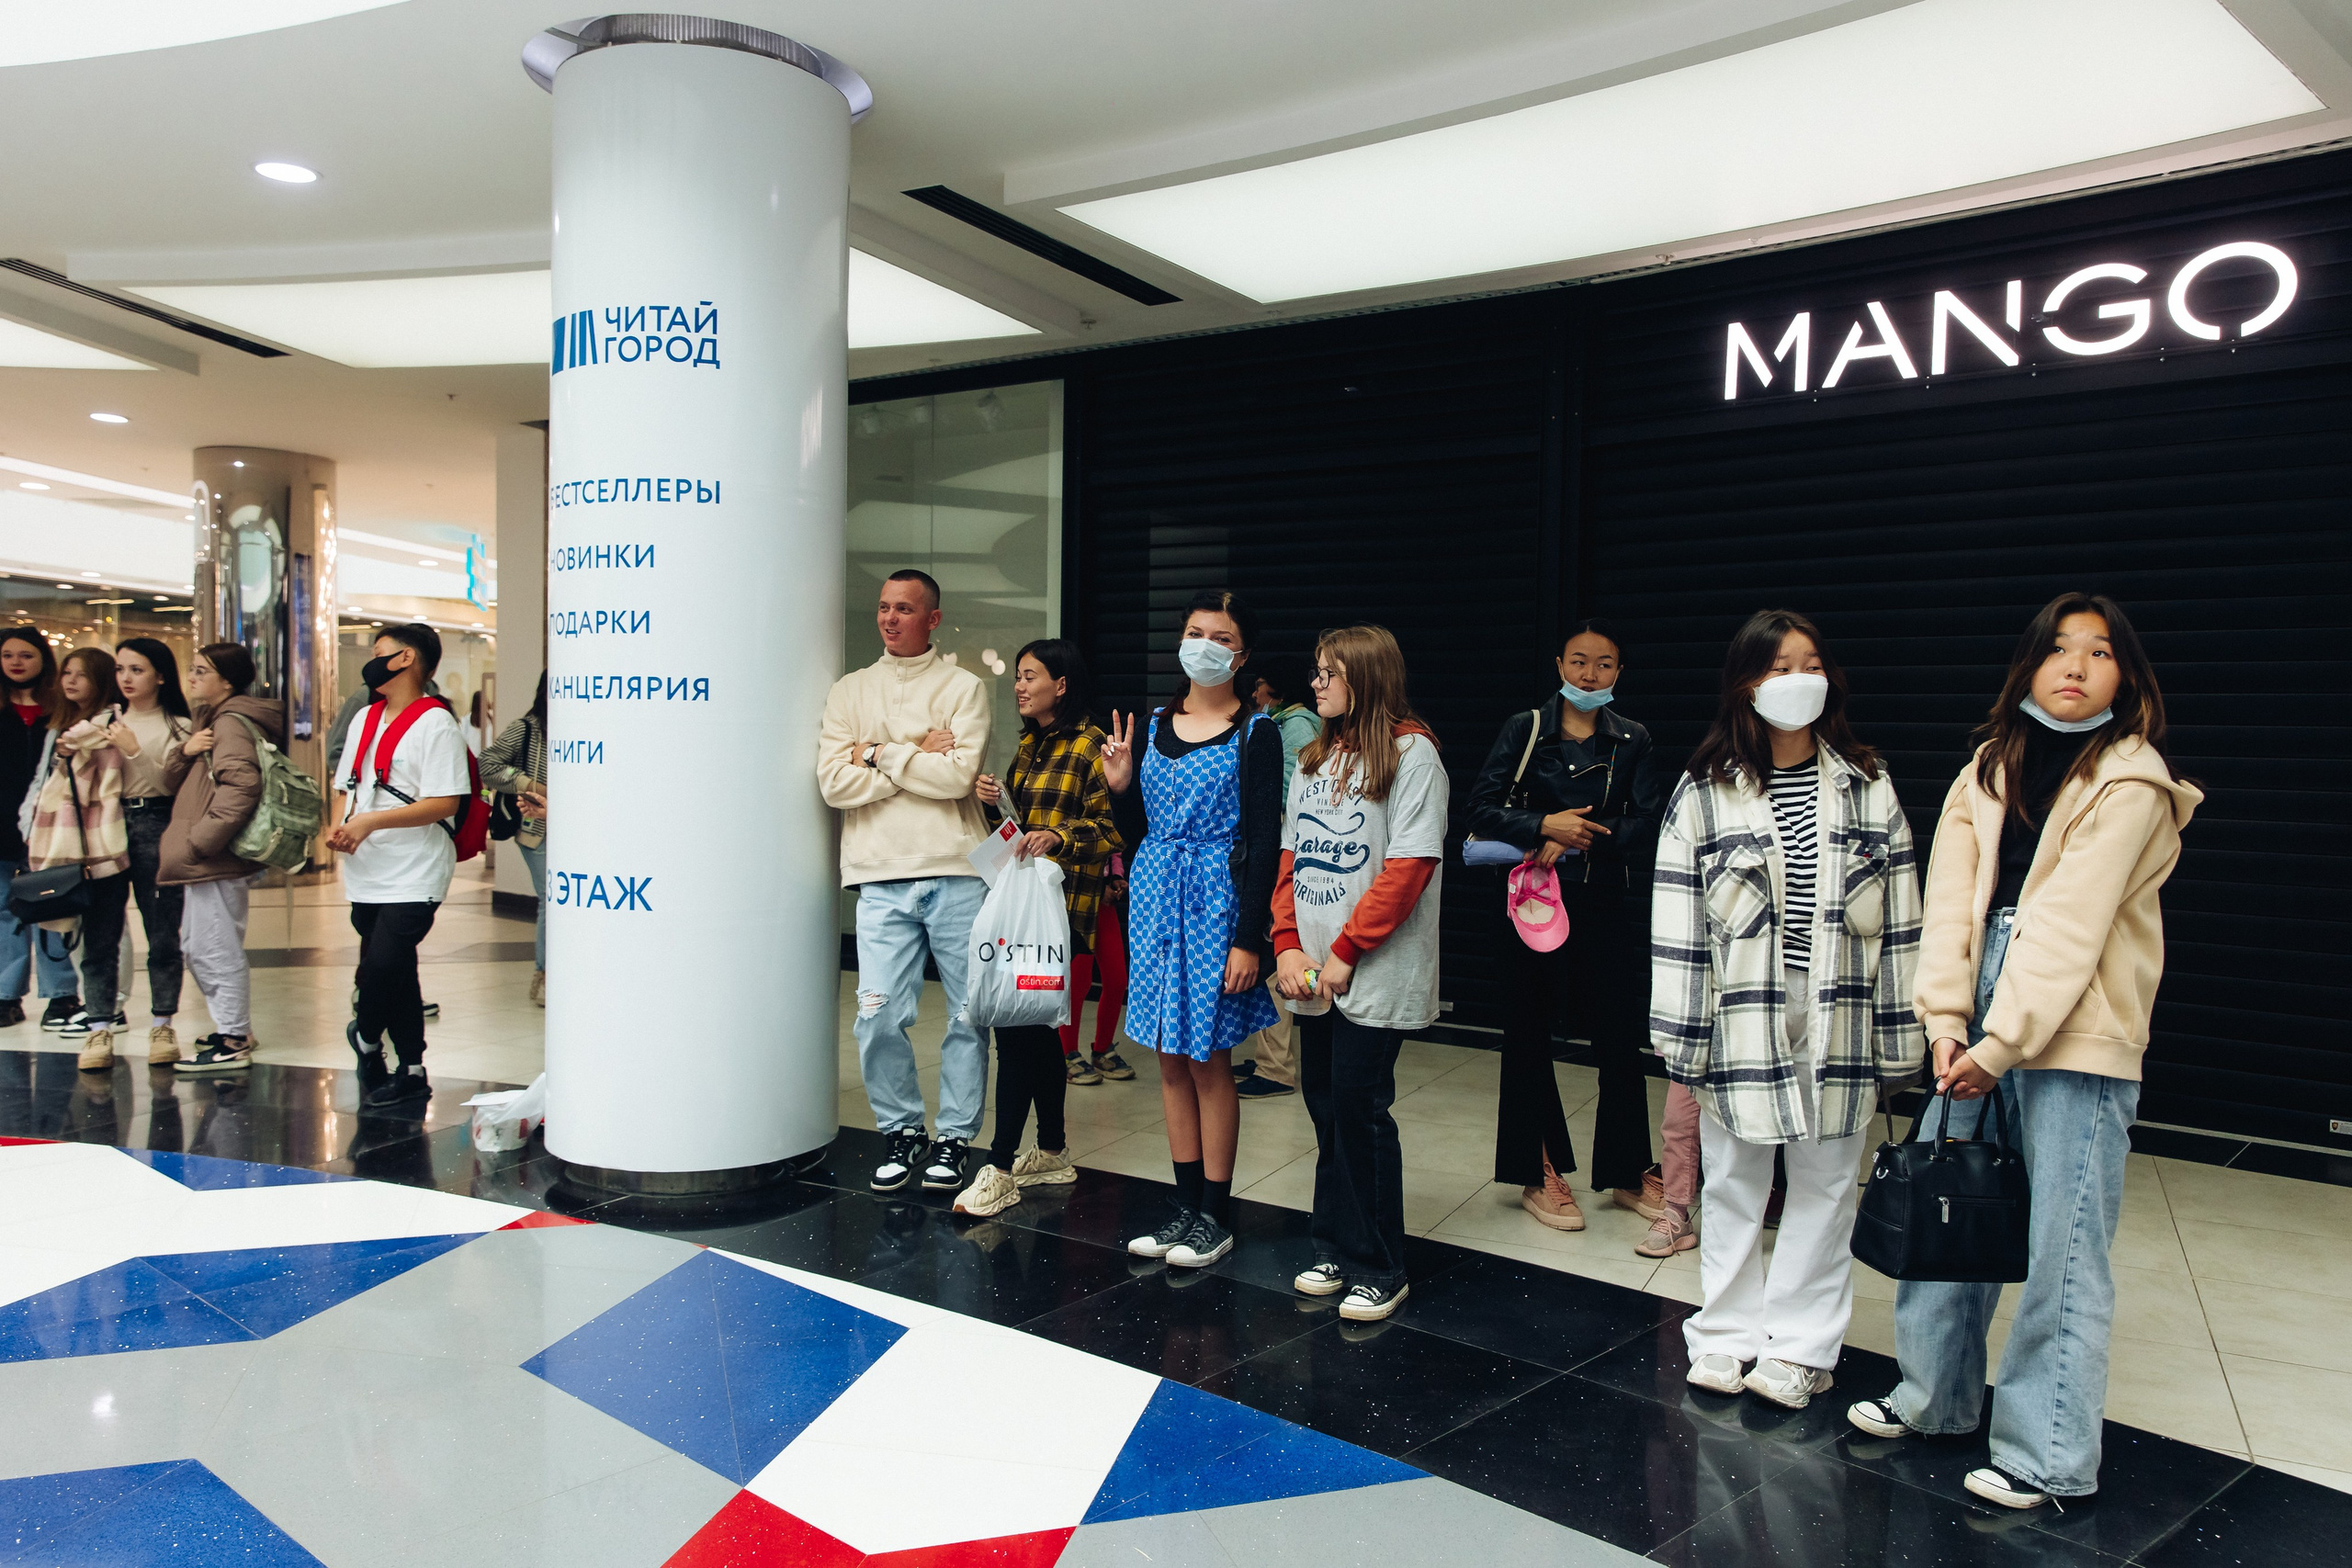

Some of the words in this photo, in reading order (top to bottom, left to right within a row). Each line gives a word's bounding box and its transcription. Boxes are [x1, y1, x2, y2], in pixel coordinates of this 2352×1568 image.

[605, 300, 718, 335] ЧИТАЙ
[1724, 241, 2298, 400] MANGO
[605, 334, 721, 369] ГОРОД
[1299, 779, 1329, 805] WEST
[557, 871, 653, 912] ЭТАЖ
[1019, 976, 1063, 987] ostin.com
